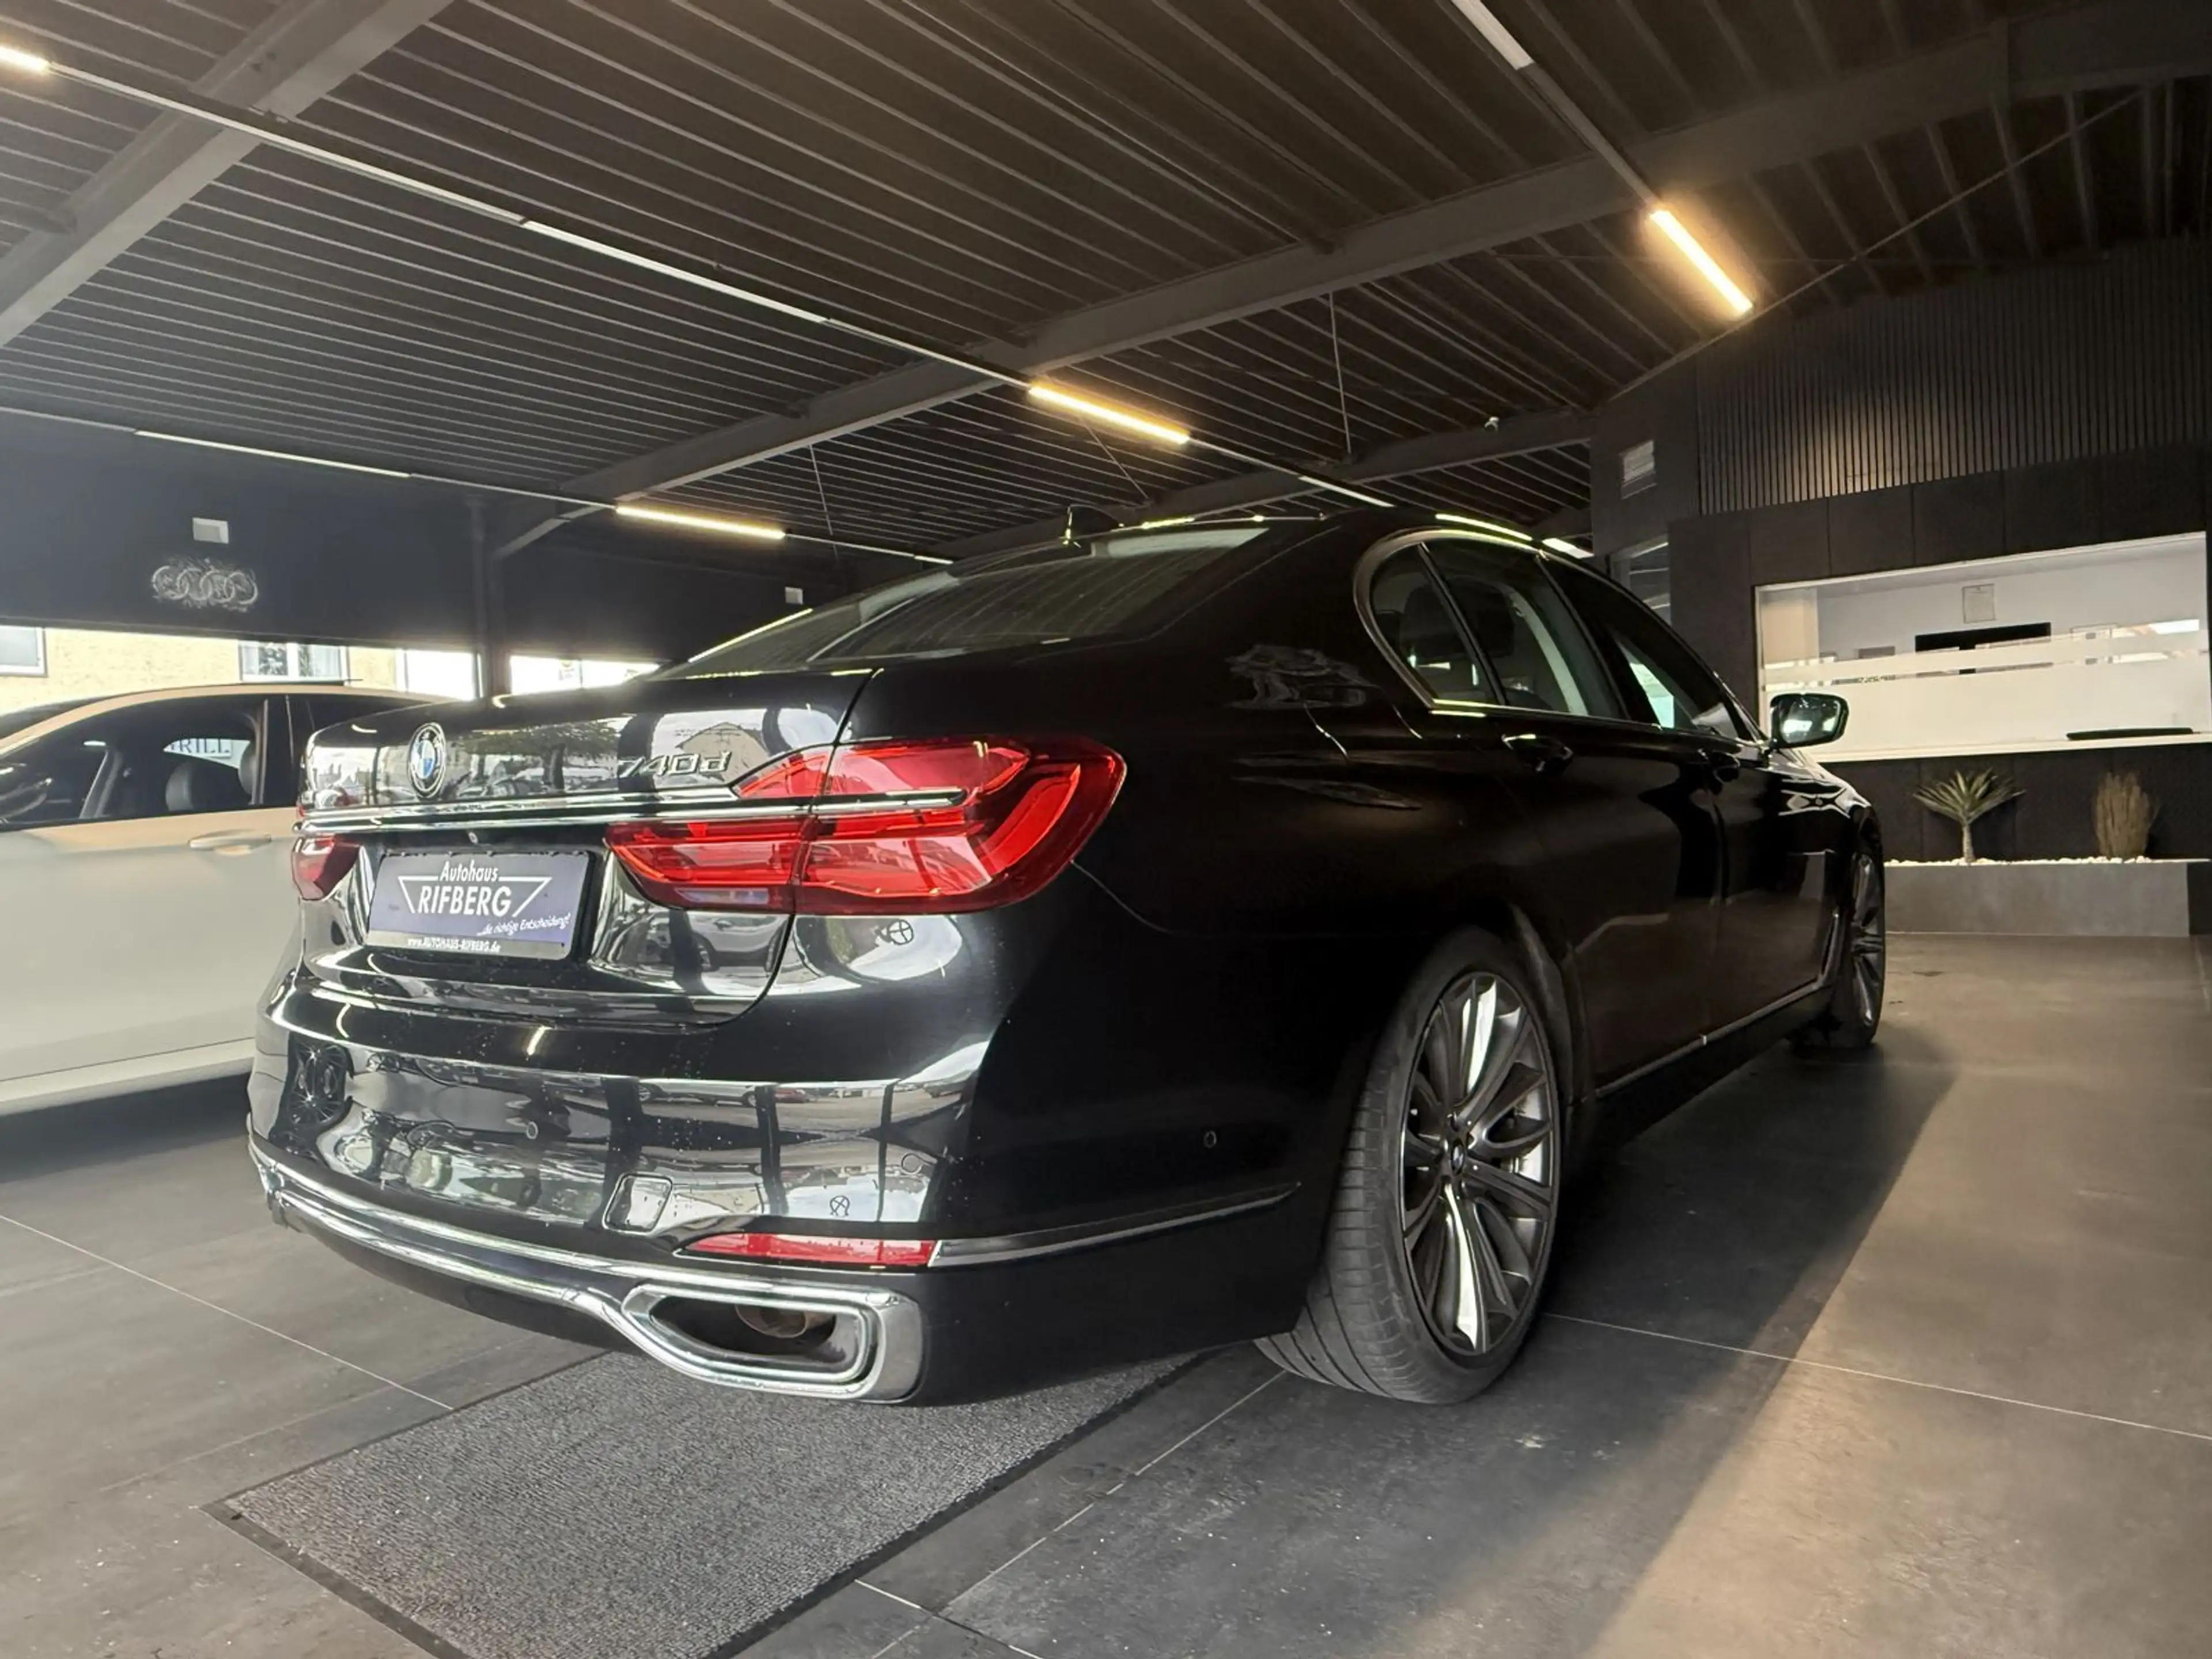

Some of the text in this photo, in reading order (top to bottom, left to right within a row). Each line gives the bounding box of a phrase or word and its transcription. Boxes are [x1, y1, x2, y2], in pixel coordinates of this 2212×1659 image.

[618, 751, 732, 778] 740d
[440, 859, 498, 881] Autohaus
[418, 885, 512, 916] RIFBERG
